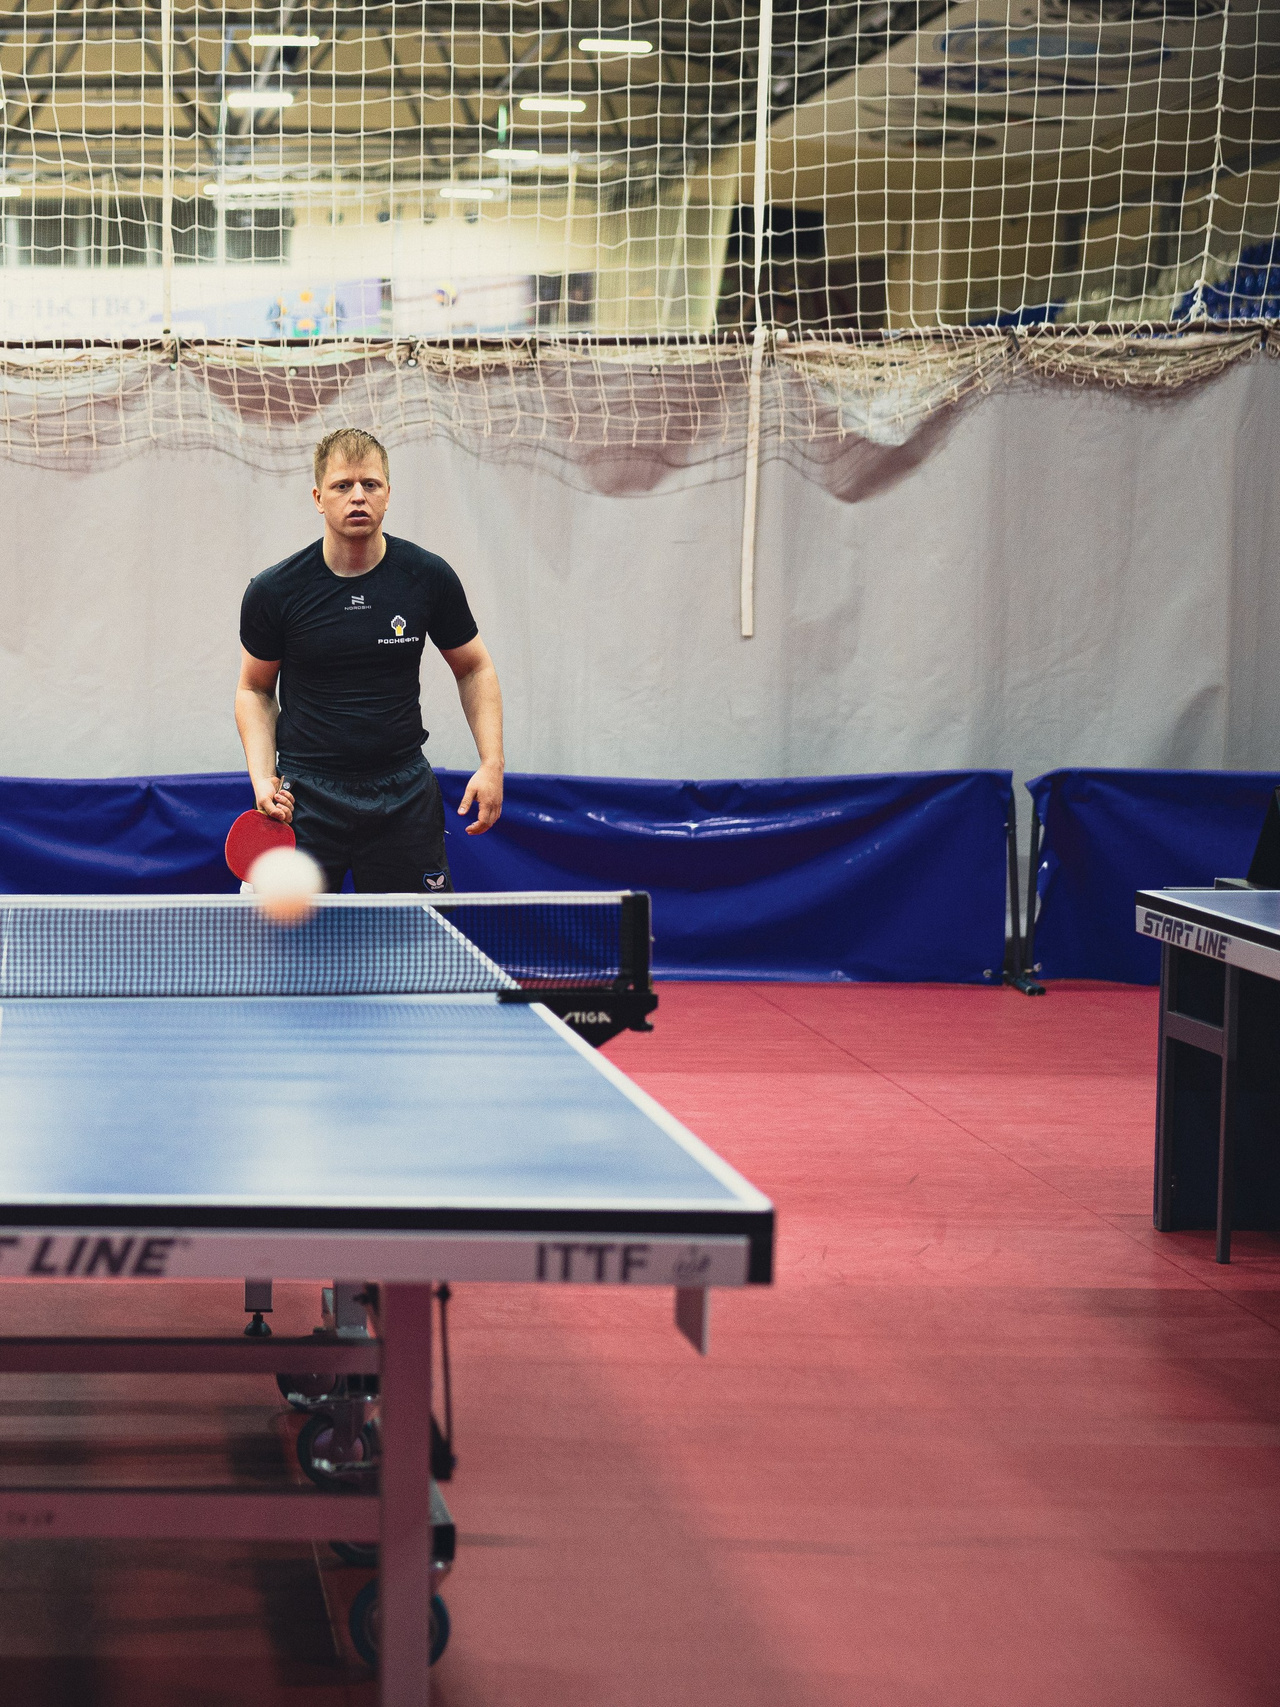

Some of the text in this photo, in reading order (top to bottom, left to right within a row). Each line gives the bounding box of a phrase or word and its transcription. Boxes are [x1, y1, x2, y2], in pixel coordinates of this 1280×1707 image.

[377, 636, 419, 644] РОСНЕФТЬ
[1143, 911, 1230, 960] START LINE
[27, 1236, 177, 1277] LINE
[535, 1242, 651, 1283] ITTF
